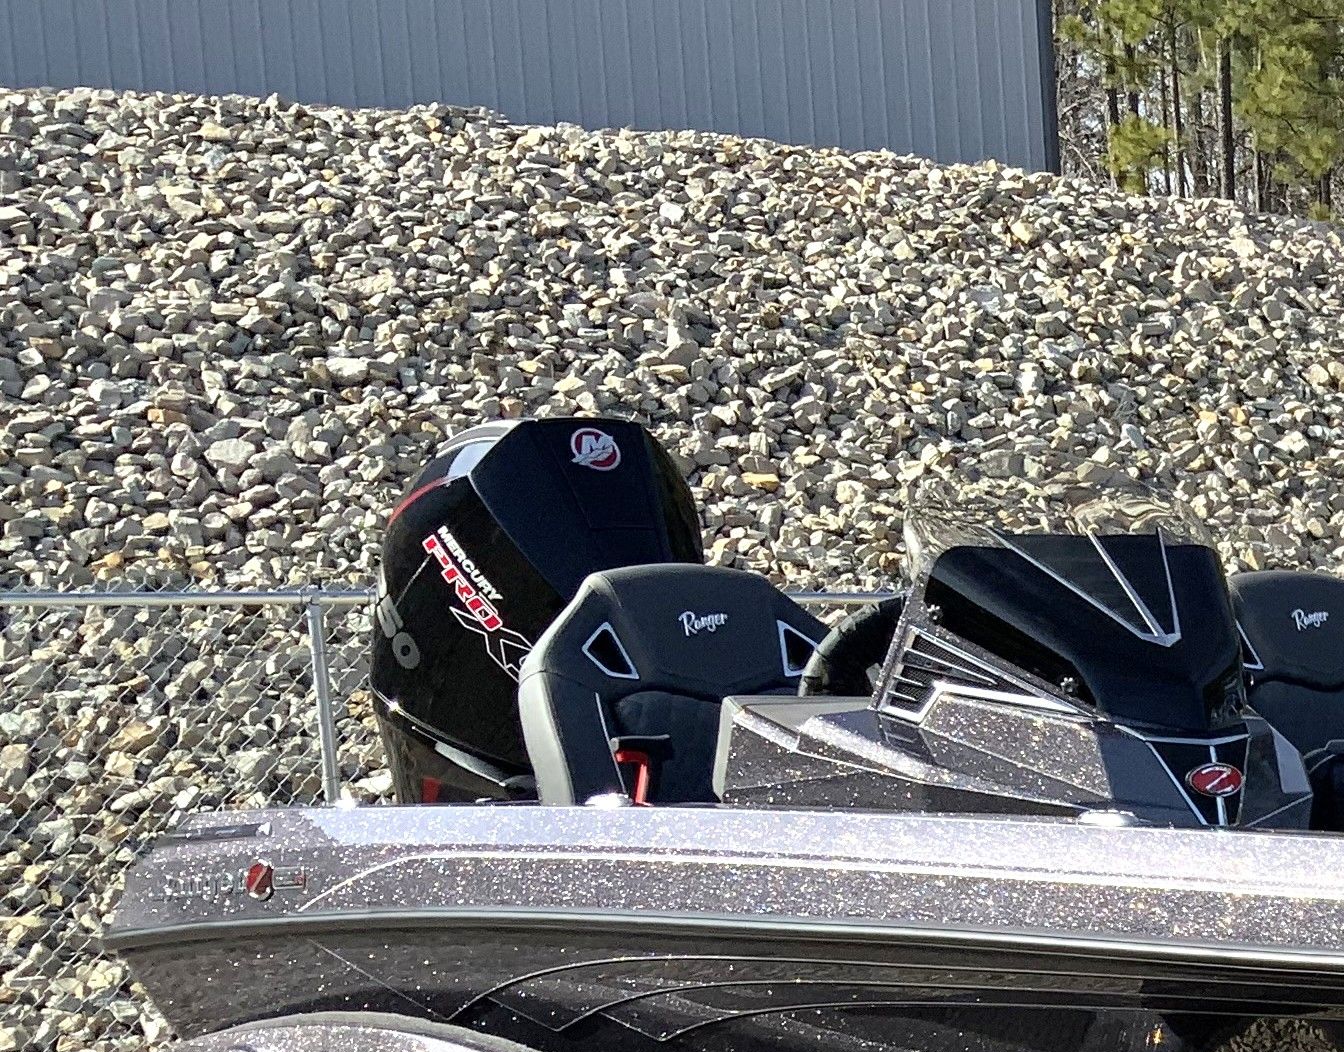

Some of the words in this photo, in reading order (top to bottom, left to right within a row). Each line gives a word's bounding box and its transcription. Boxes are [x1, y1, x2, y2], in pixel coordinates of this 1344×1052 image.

[422, 534, 503, 632] PRO
[436, 525, 503, 600] MERCURY
[678, 611, 728, 637] Ranger
[1291, 608, 1329, 632] Ranger
